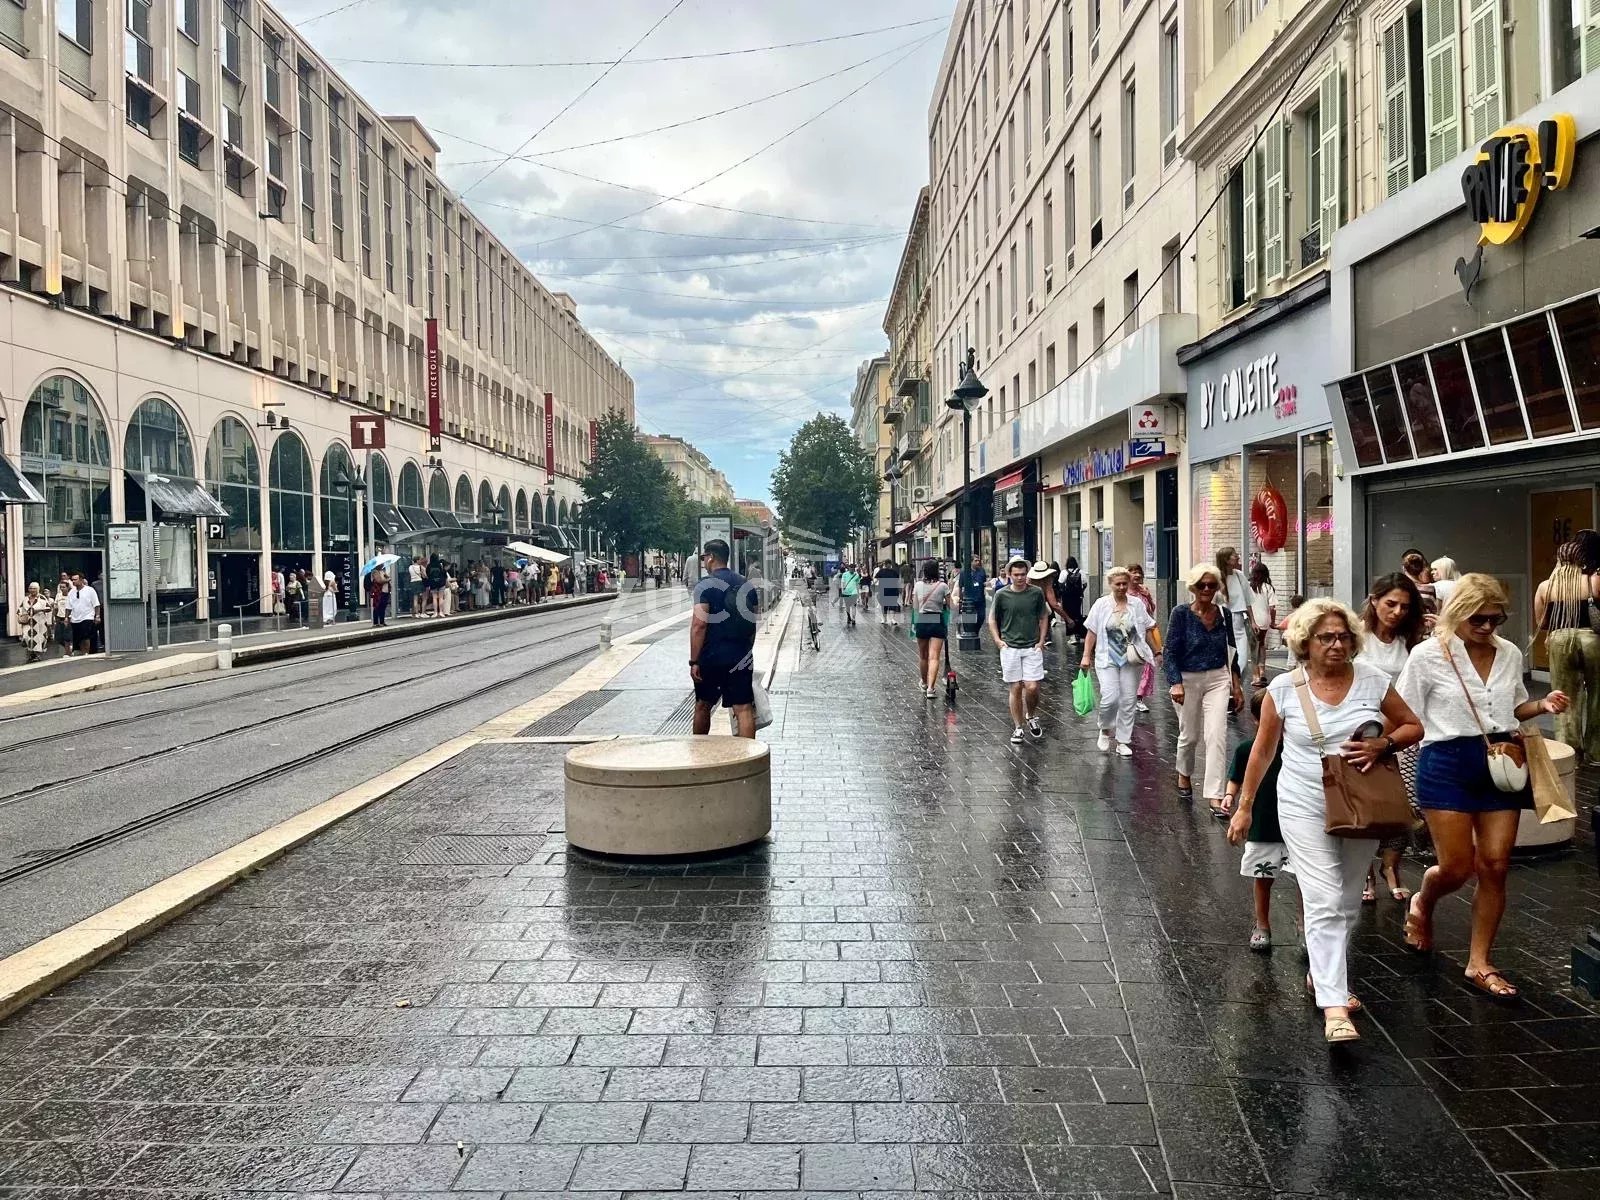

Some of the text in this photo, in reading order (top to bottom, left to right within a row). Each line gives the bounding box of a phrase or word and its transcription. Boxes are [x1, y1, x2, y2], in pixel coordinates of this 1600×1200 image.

[1200, 351, 1280, 429] BY COLETTE
[355, 421, 379, 445] T
